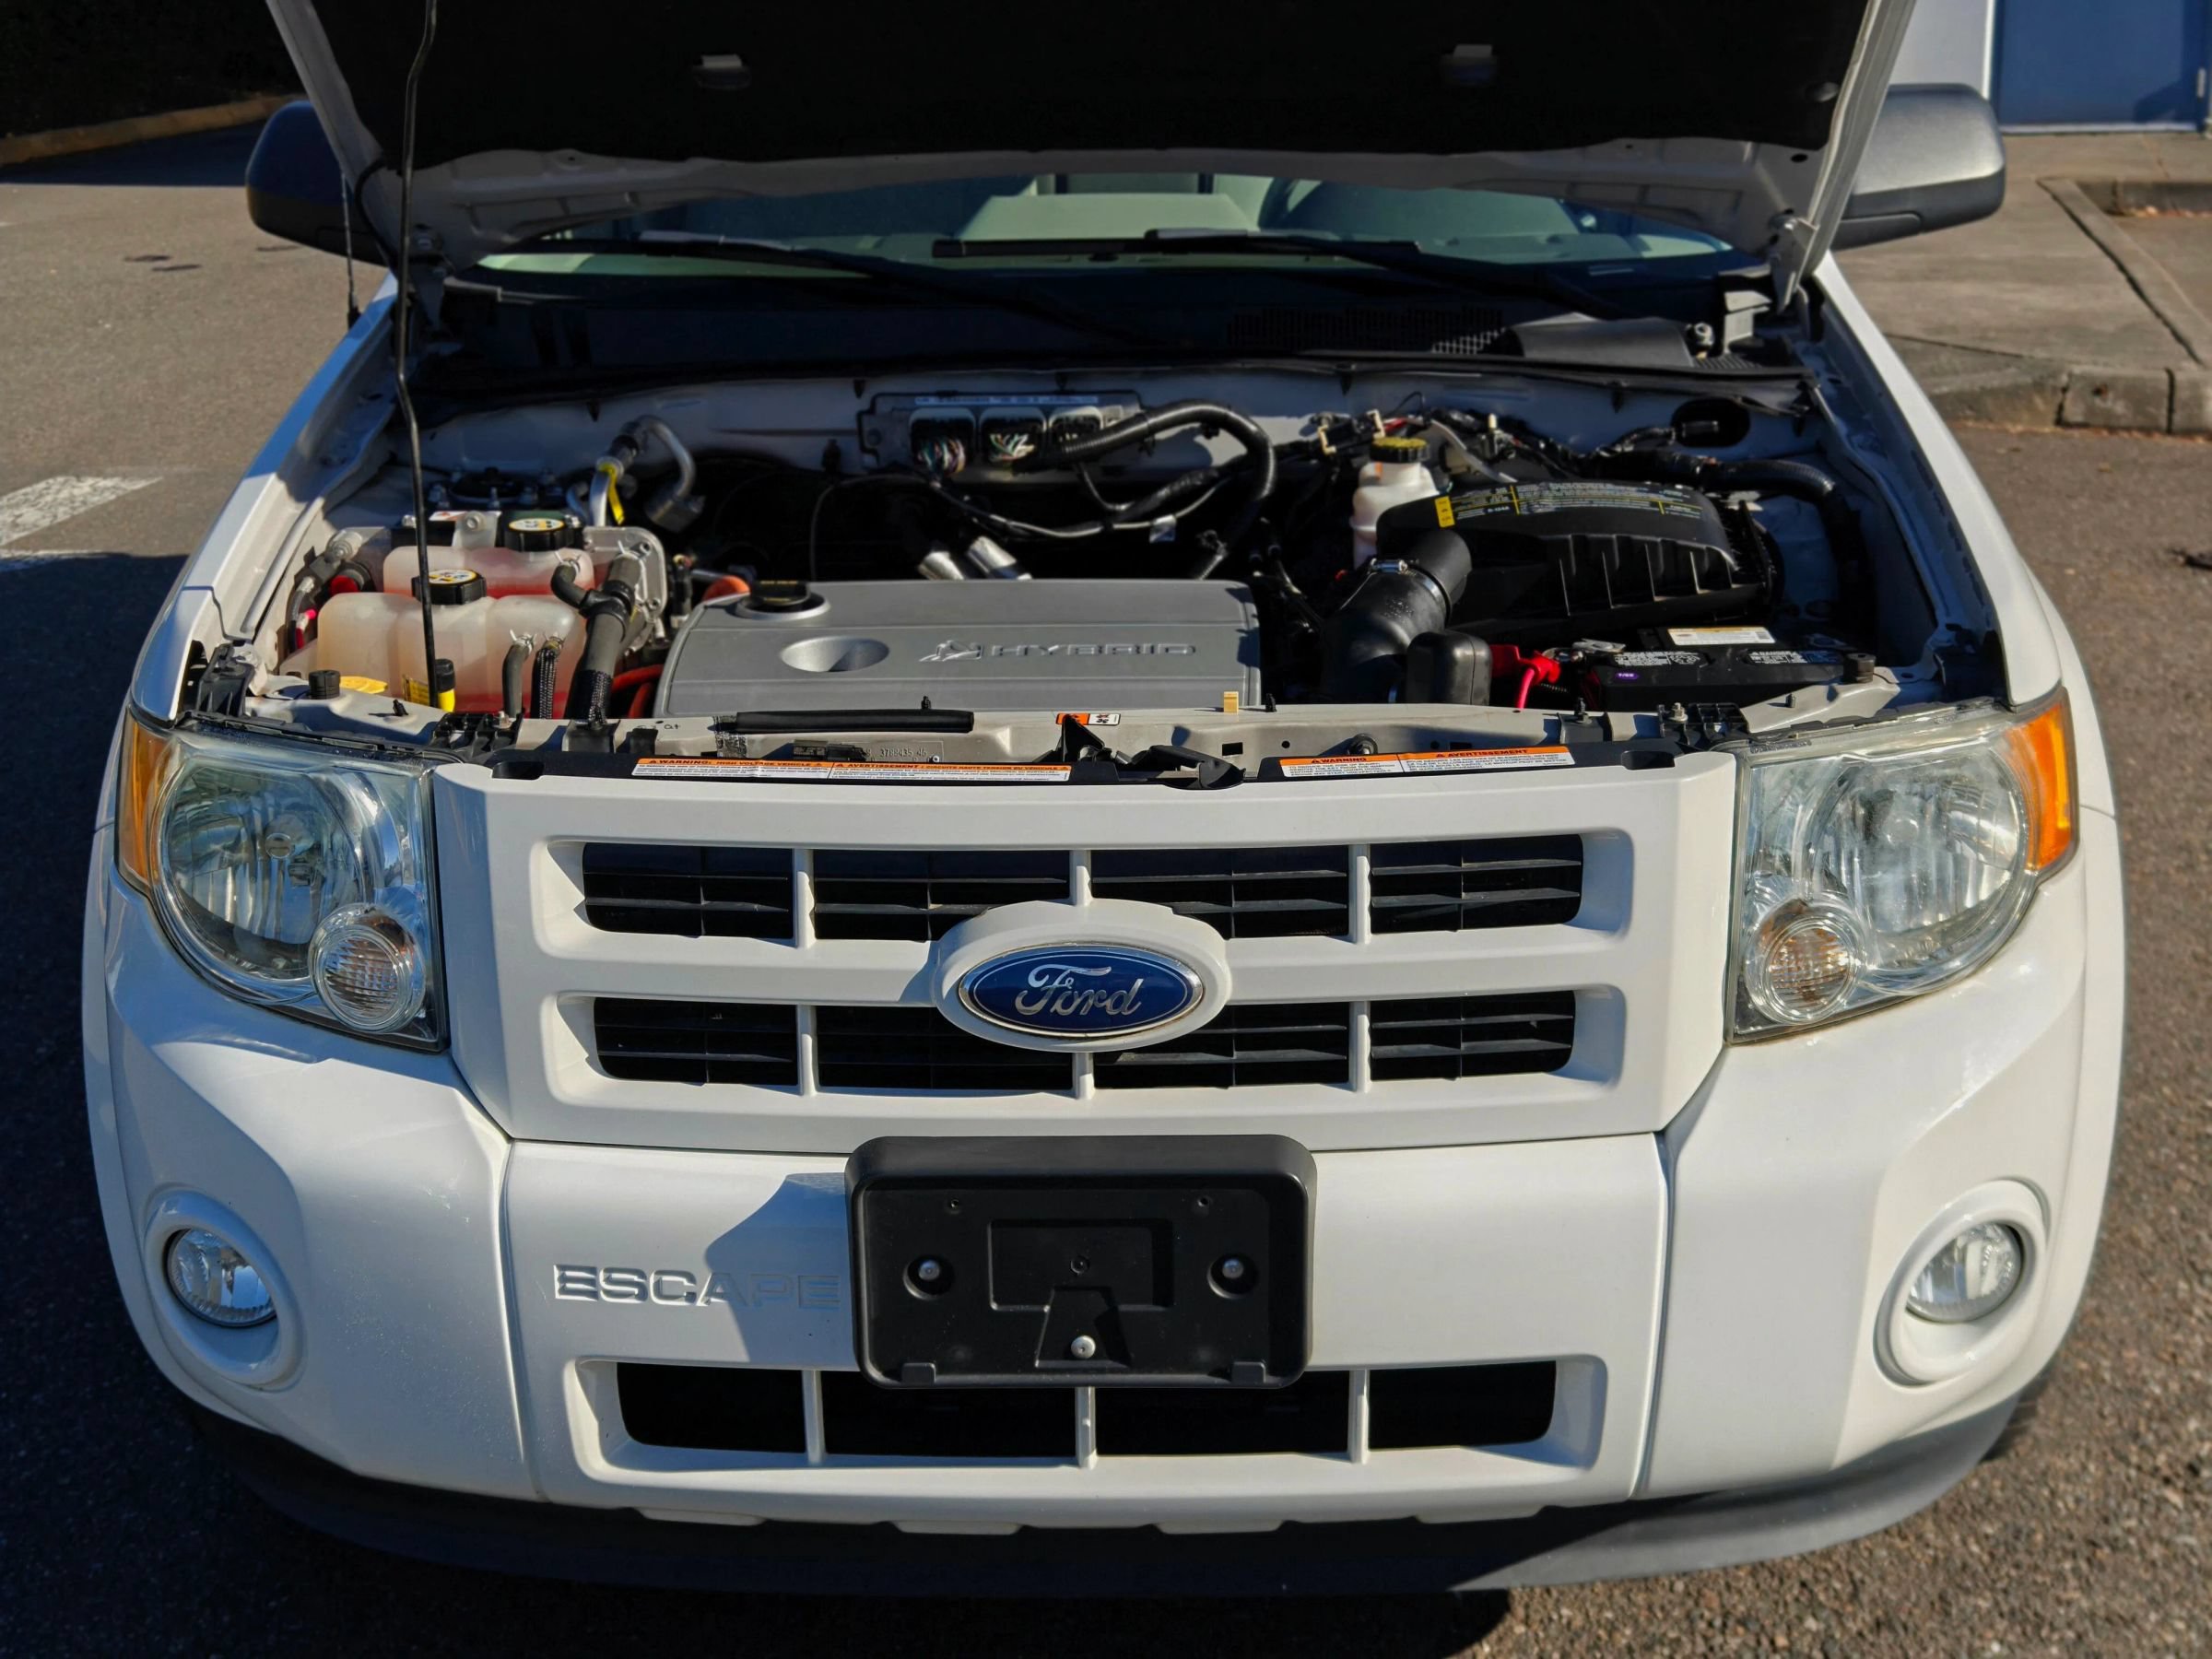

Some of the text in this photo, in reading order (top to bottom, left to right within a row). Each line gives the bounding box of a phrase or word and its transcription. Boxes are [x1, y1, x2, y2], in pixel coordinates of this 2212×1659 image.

[991, 643, 1196, 657] HYBRID
[1448, 749, 1529, 758] AVERTISSEMENT
[1014, 963, 1145, 1016] Ford
[553, 1264, 841, 1309] ESCAPE
